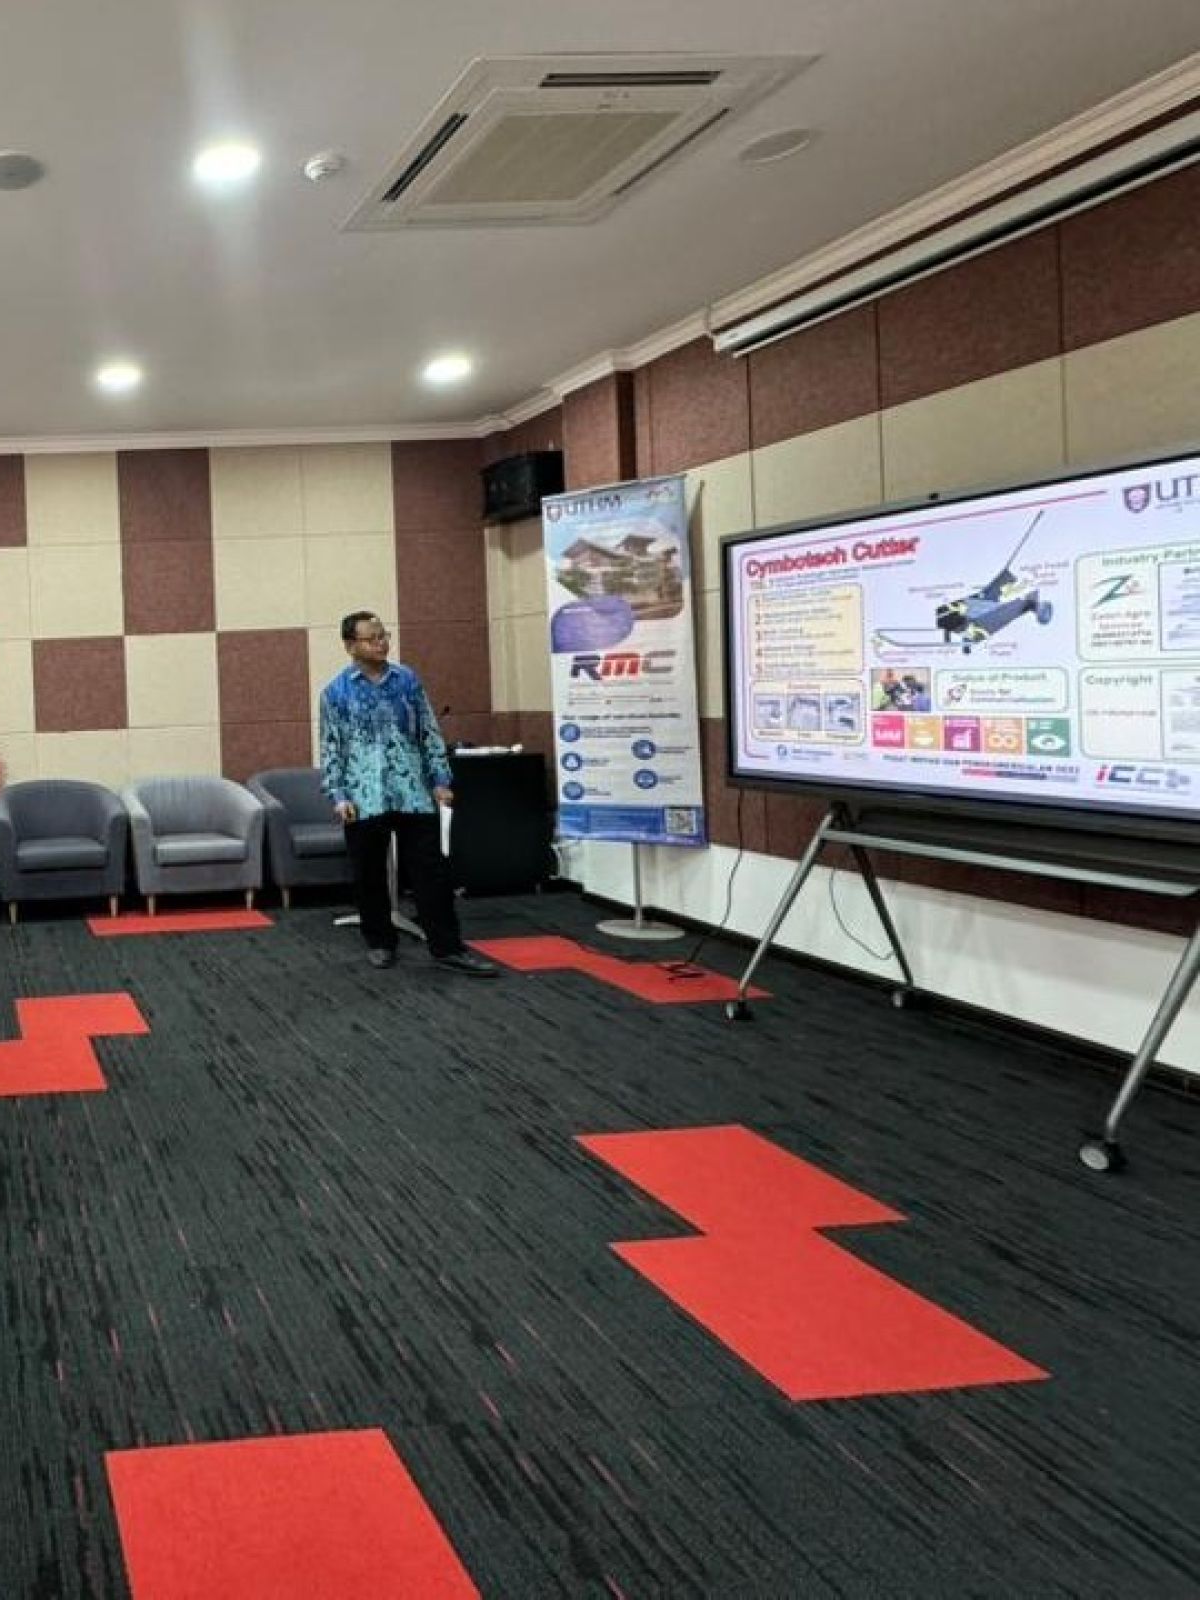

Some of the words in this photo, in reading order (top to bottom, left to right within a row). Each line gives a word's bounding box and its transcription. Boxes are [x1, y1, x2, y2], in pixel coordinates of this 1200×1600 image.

[1155, 474, 1200, 501] UT
[570, 650, 676, 681] RMC
[1085, 674, 1153, 687] Copyright
